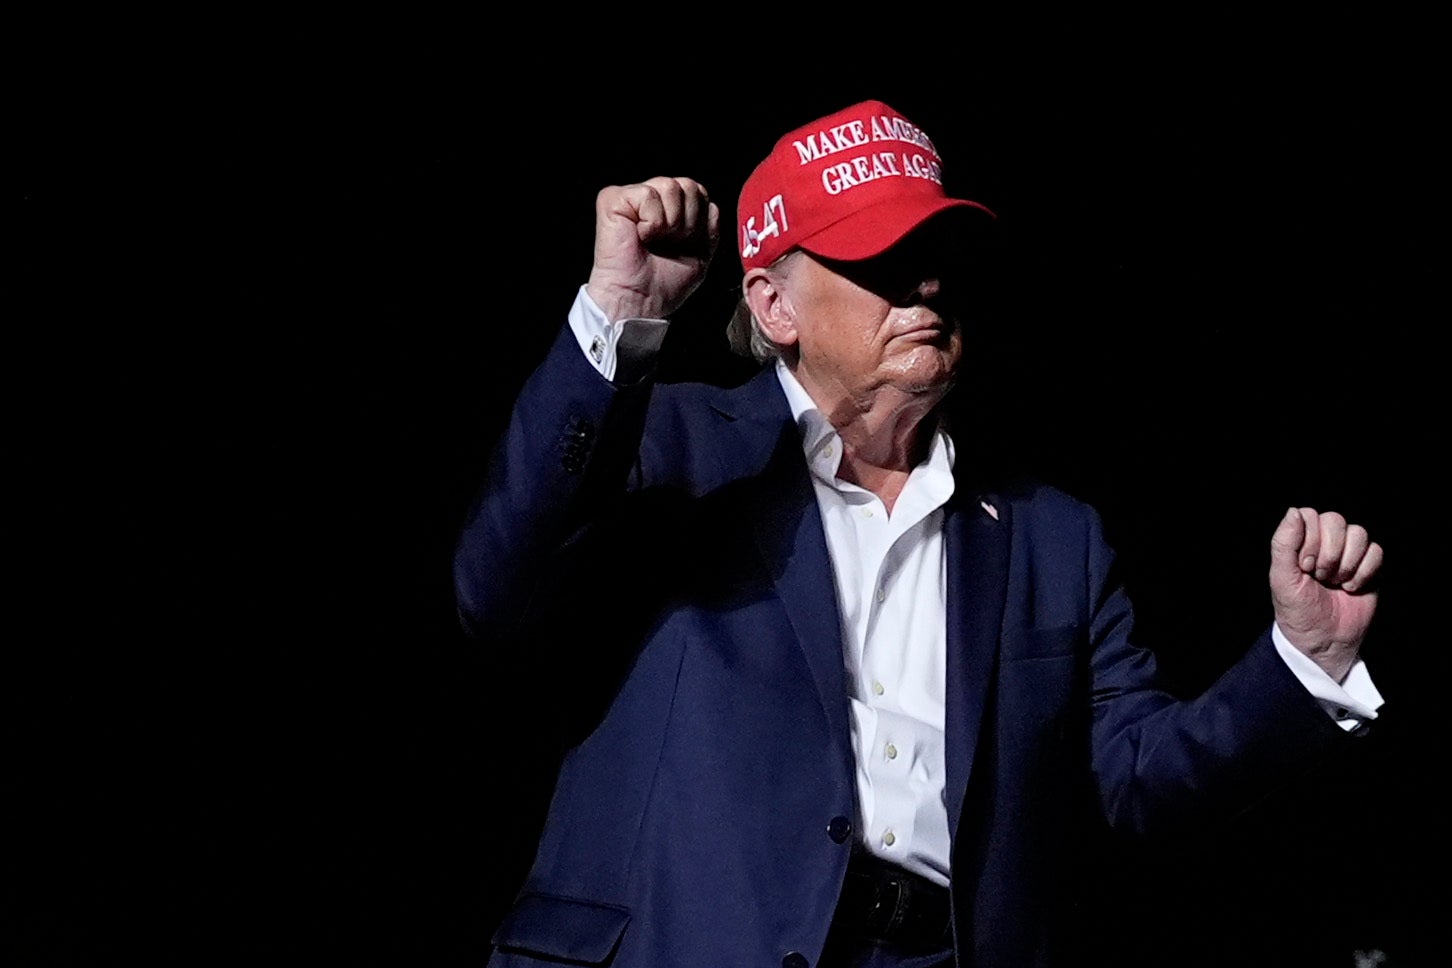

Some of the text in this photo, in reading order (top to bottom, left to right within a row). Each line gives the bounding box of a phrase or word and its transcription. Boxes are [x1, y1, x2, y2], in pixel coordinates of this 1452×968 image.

[792, 120, 870, 165] MAKE
[821, 152, 943, 195] GREAT AGA
[741, 194, 789, 259] 45-47
